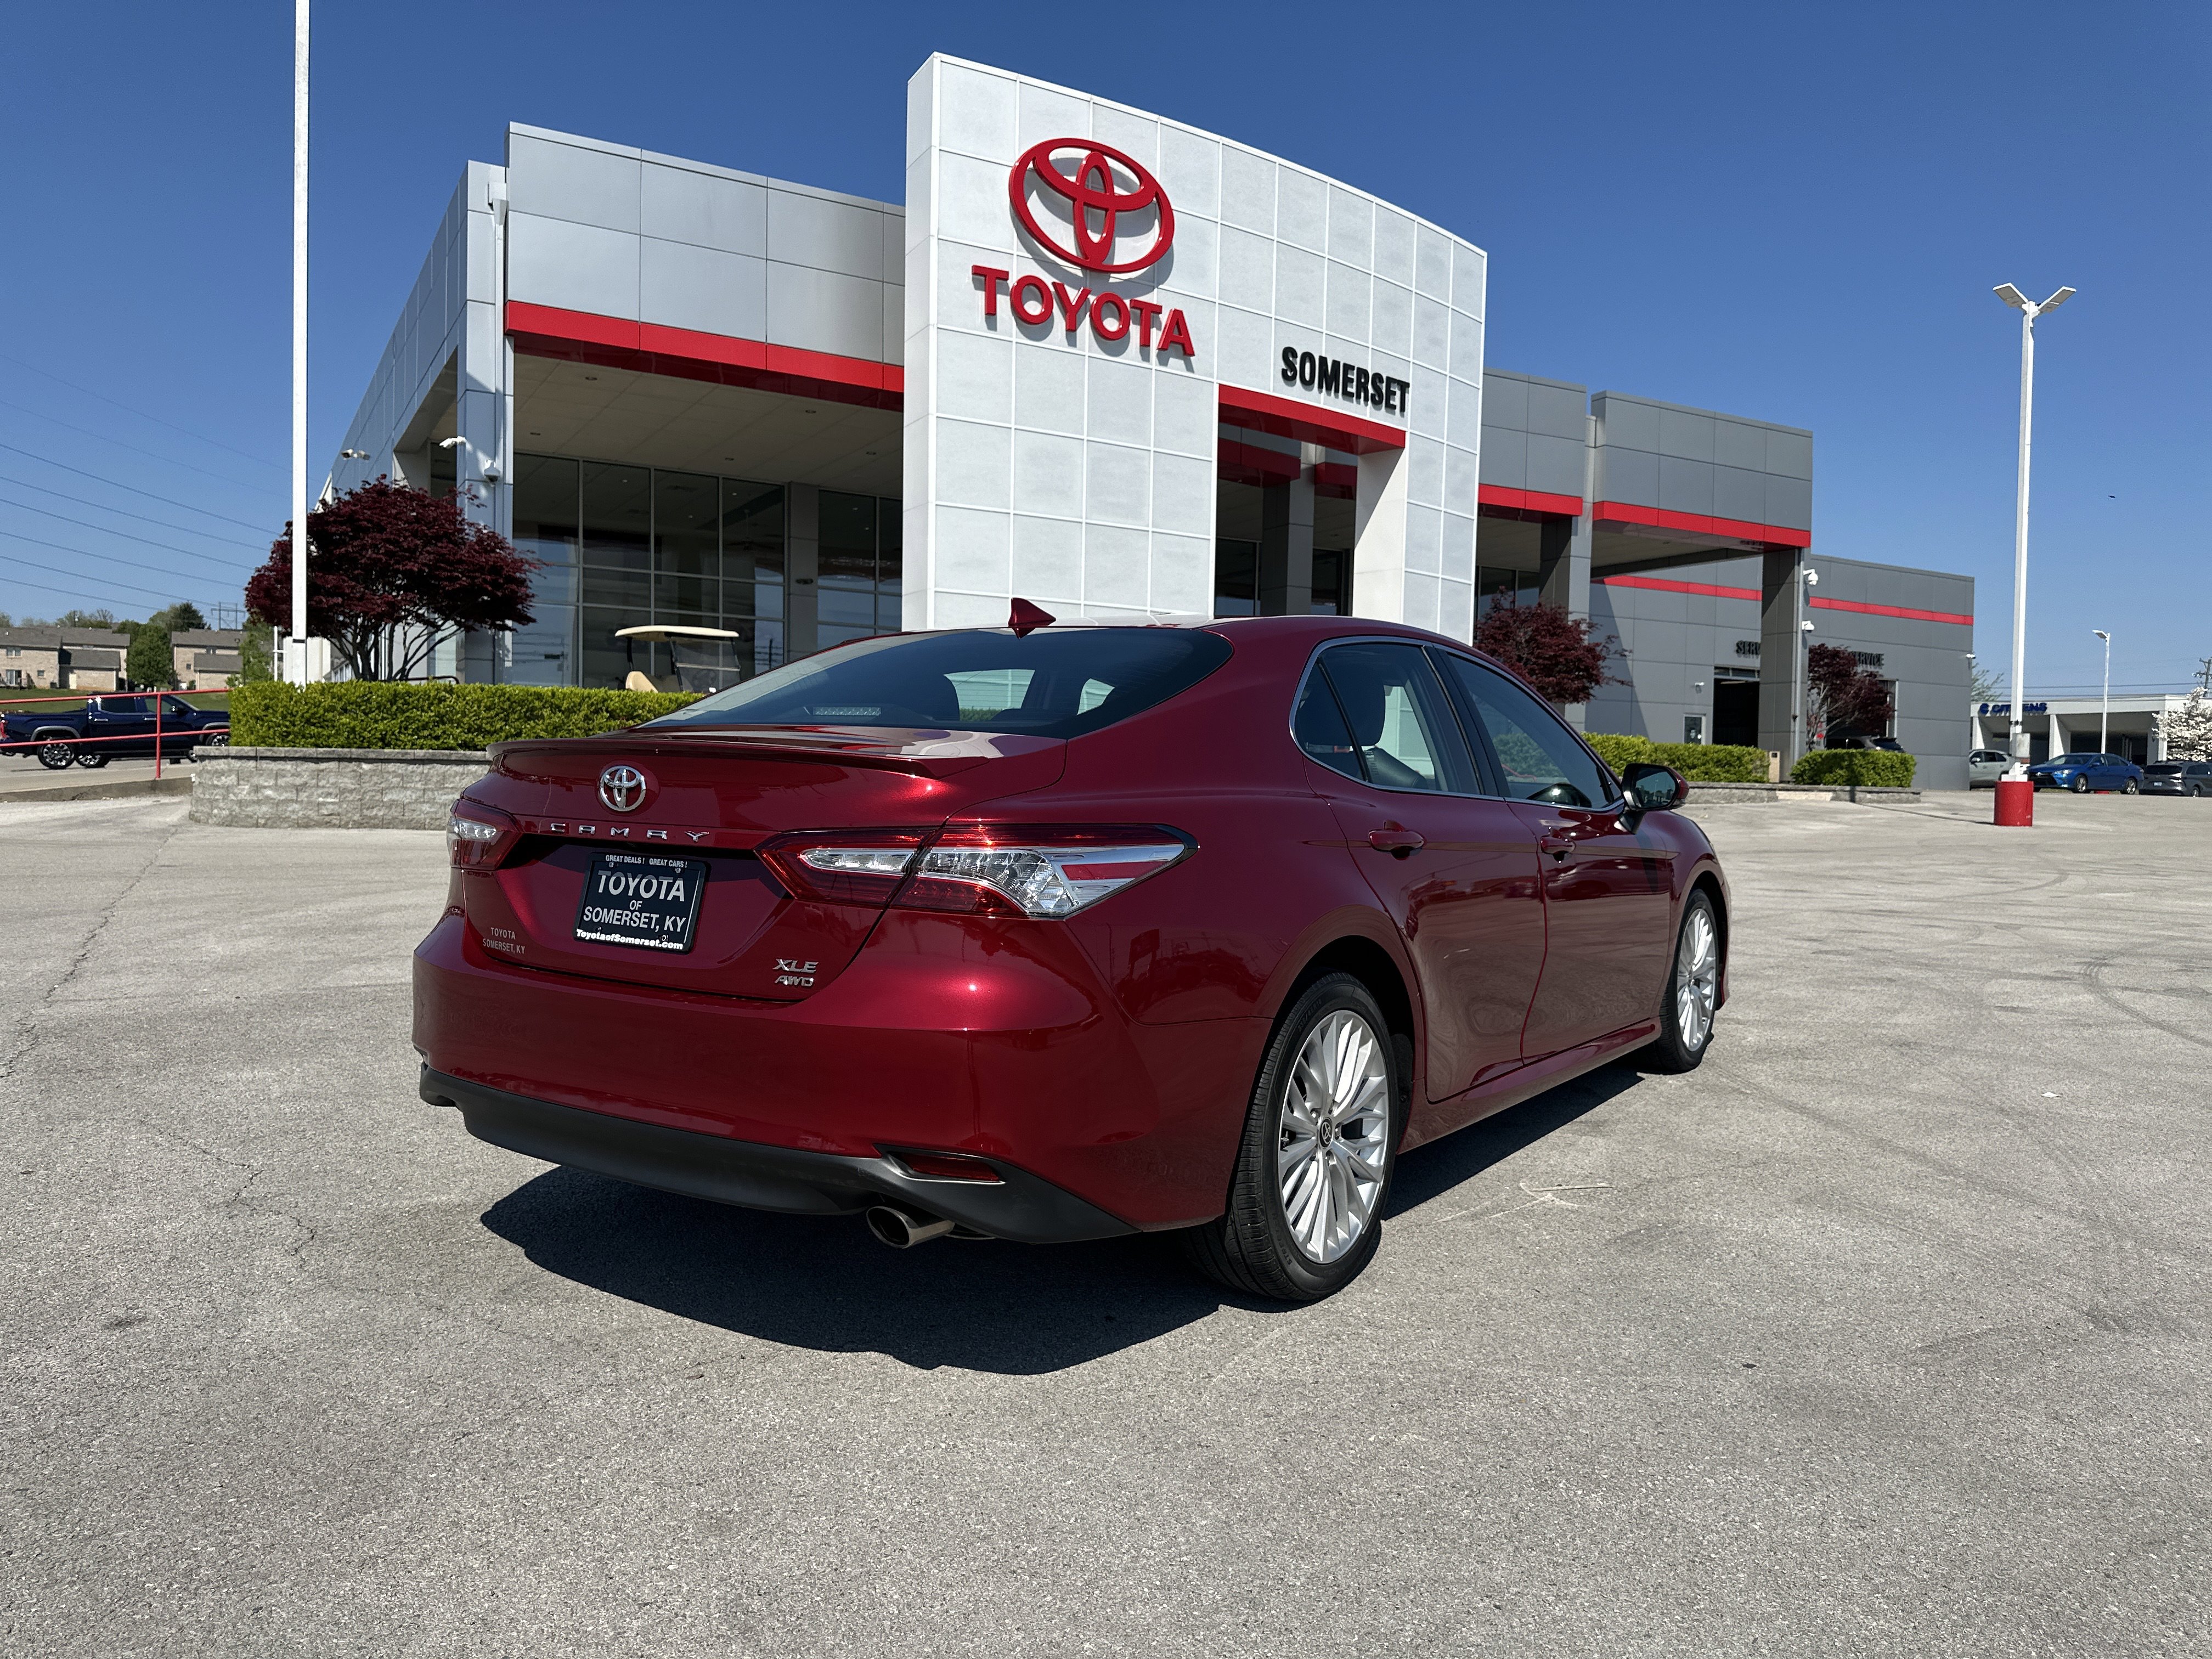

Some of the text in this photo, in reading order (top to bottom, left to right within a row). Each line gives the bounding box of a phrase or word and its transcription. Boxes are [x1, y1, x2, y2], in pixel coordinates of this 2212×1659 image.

[972, 264, 1195, 357] TOYOTA
[1281, 346, 1410, 413] SOMERSET
[1736, 640, 1760, 655] SERV
[1991, 702, 2047, 712] CITENS
[550, 823, 710, 842] CAMRY
[605, 854, 623, 862] GREAT
[597, 870, 685, 902] TOYOTA
[629, 900, 642, 911] OF
[583, 906, 686, 933] SOMERSET, KY
[490, 927, 516, 940] TOYOTA
[576, 929, 684, 950] ToyotaofSomerset.com
[483, 938, 526, 954] SOMERSET, KY
[772, 958, 819, 973] XLE
[774, 975, 814, 986] AWD
